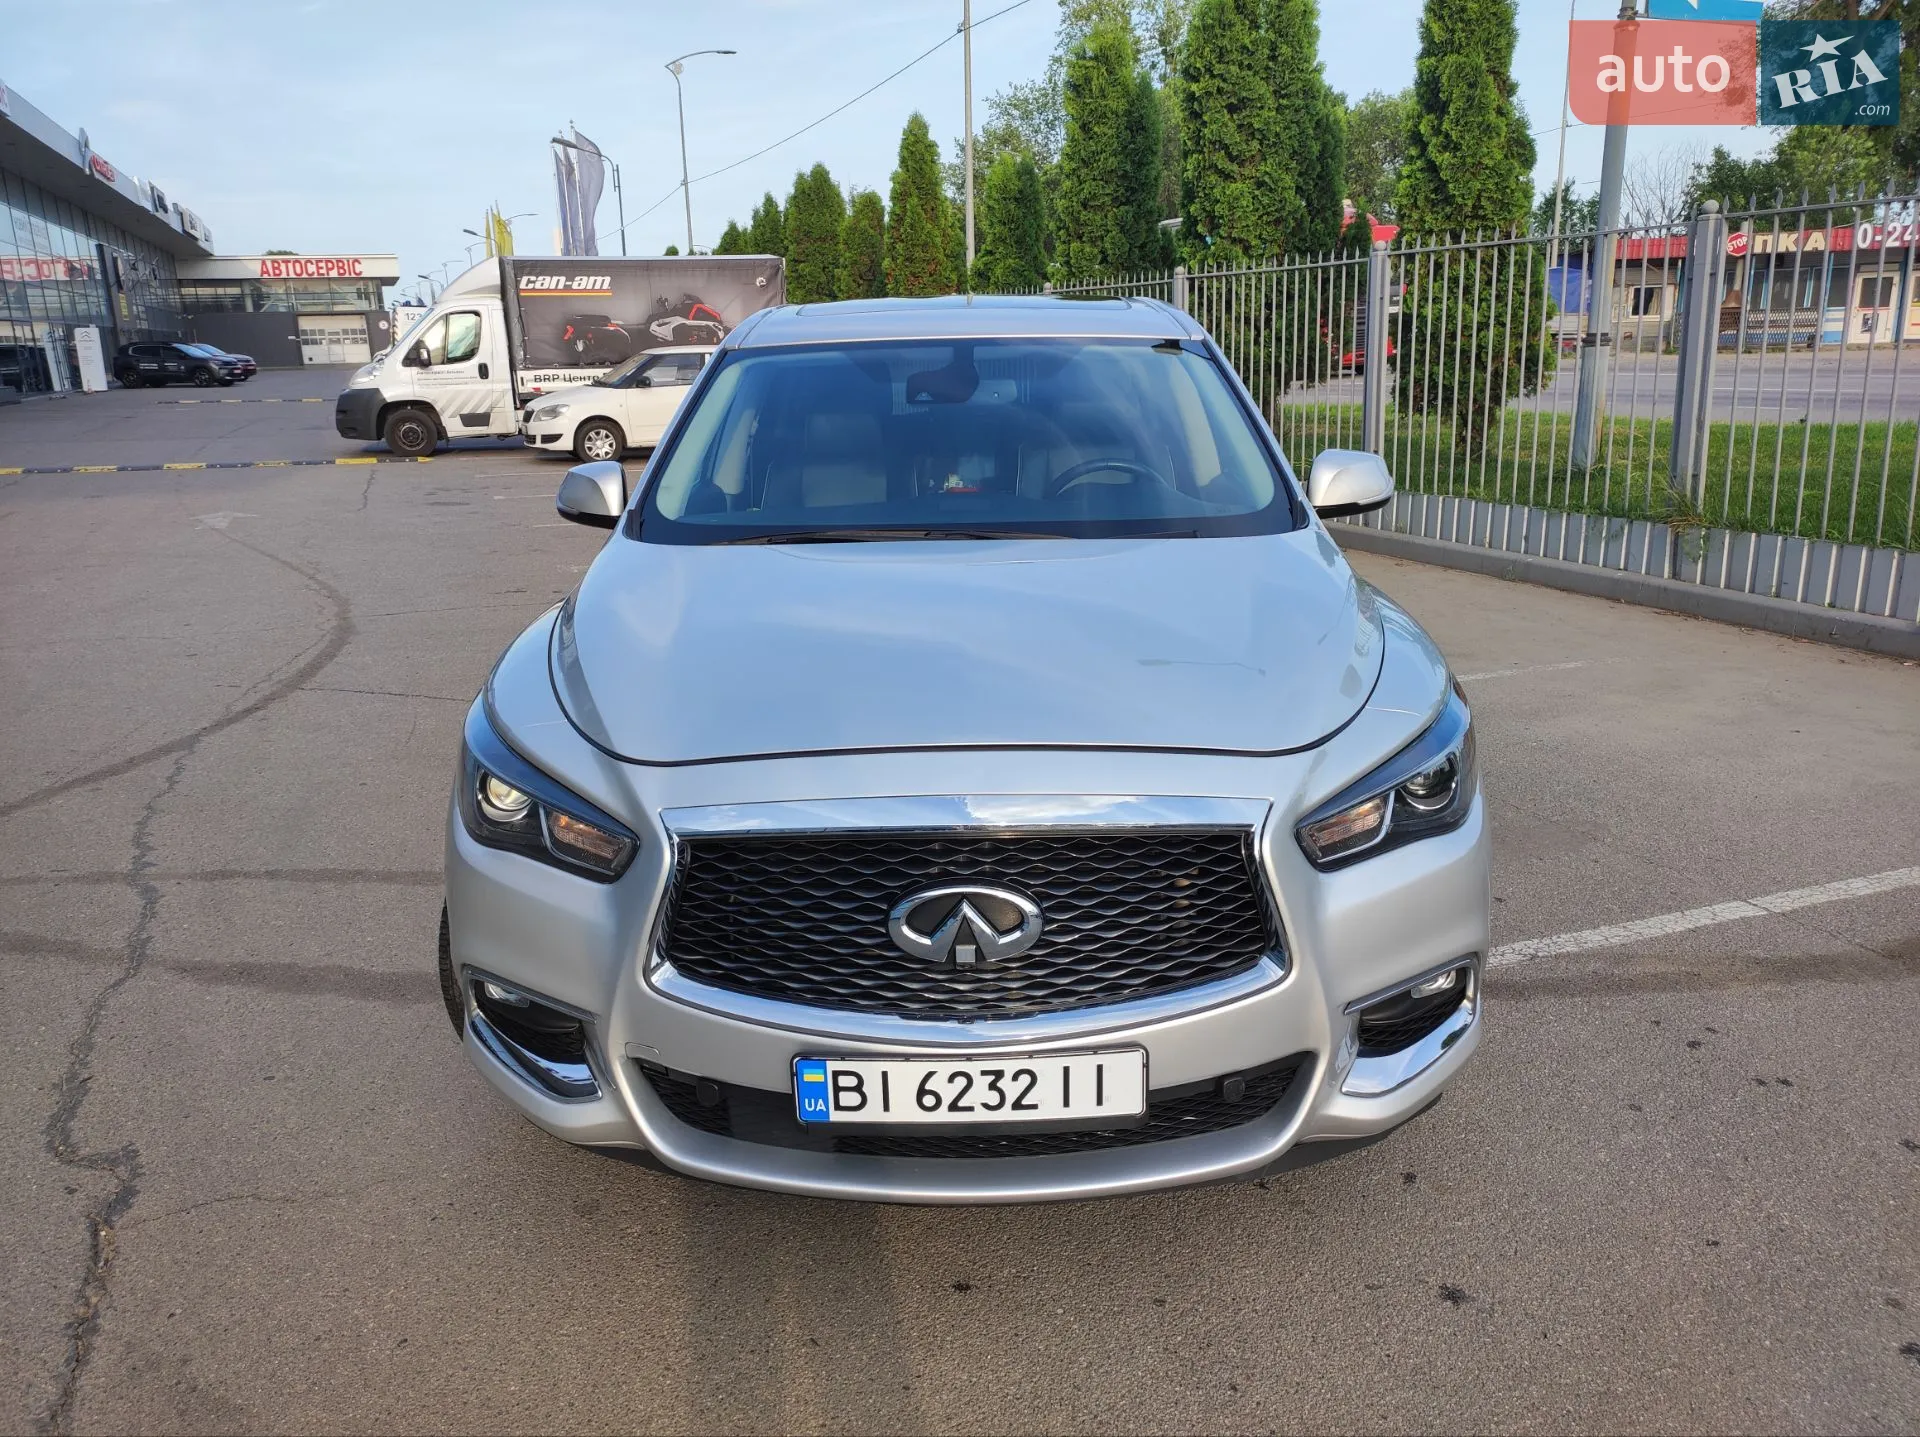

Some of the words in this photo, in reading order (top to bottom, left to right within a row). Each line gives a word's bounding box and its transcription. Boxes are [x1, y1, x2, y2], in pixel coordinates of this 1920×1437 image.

[1727, 235, 1748, 252] STOP
[260, 259, 363, 277] АВТОСЕРВІС
[519, 275, 611, 289] can-am
[534, 374, 560, 383] BRP
[805, 1098, 827, 1112] UA
[916, 1068, 1039, 1113] 6232
